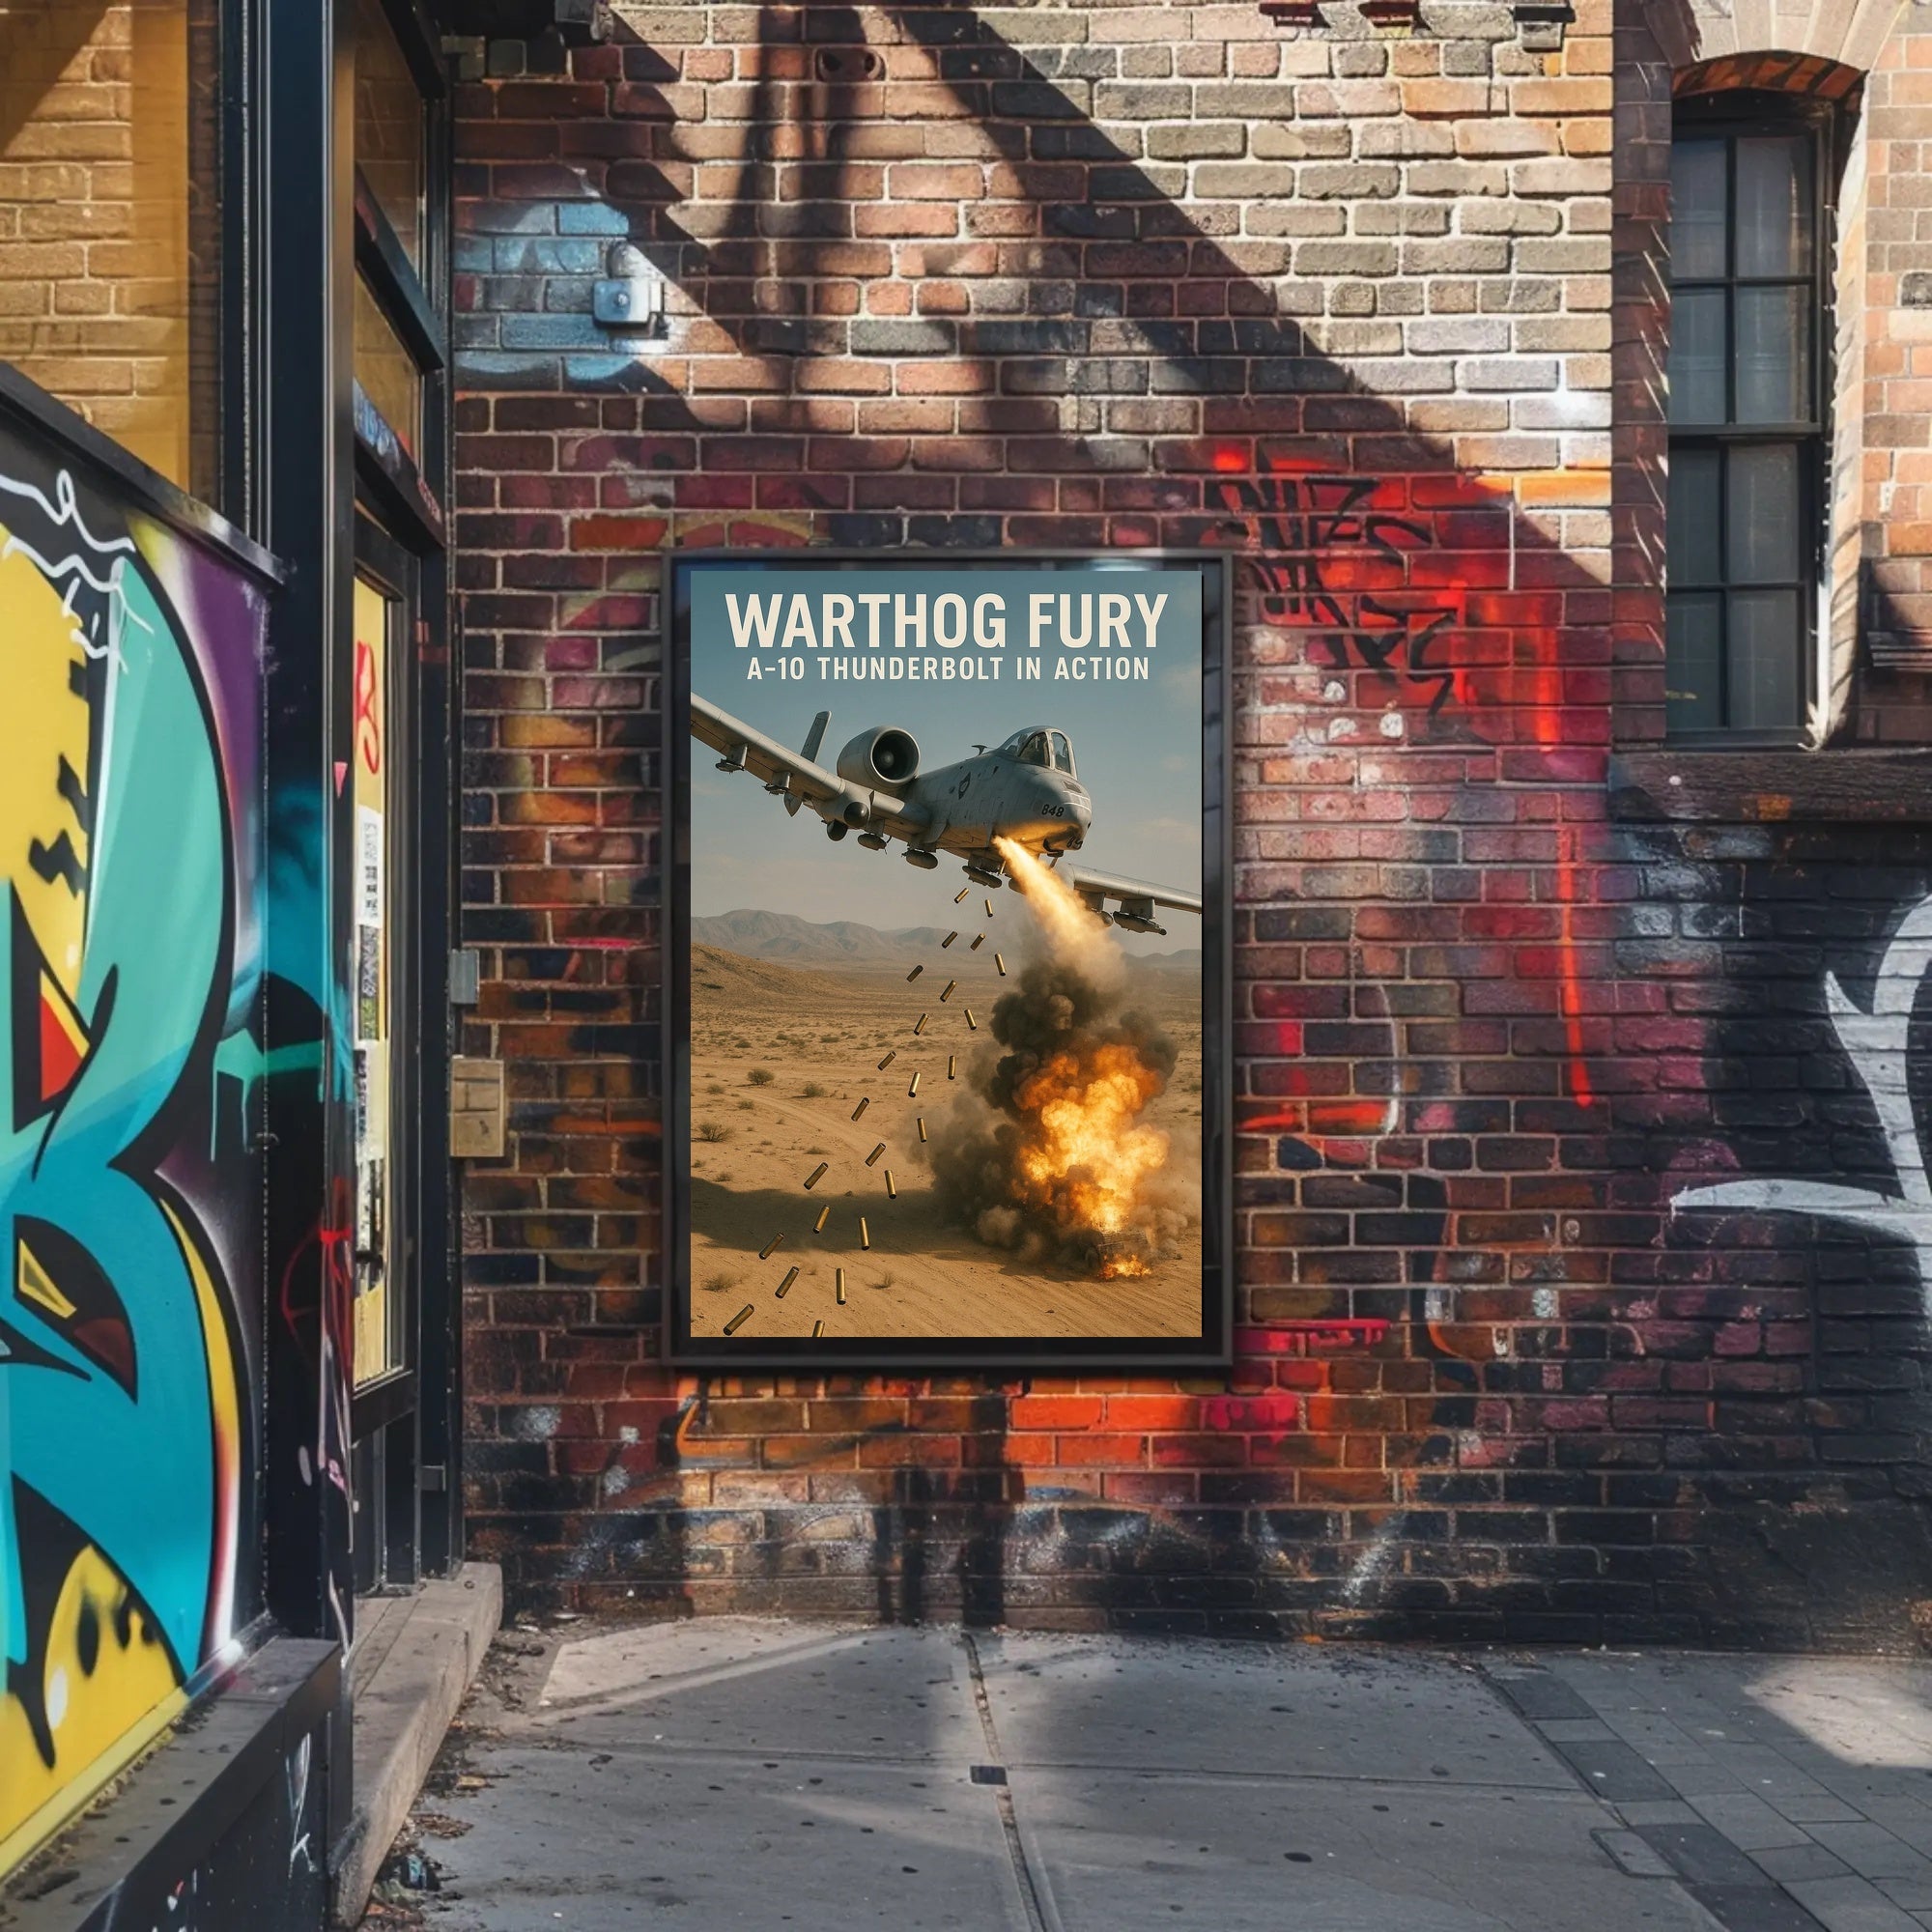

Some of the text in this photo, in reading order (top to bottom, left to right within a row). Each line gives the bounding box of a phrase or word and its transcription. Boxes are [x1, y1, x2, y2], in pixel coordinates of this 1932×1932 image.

[724, 593, 1169, 648] WARTHOG FURY
[747, 656, 1149, 680] A-10 THUNDERBOLT IN ACTION
